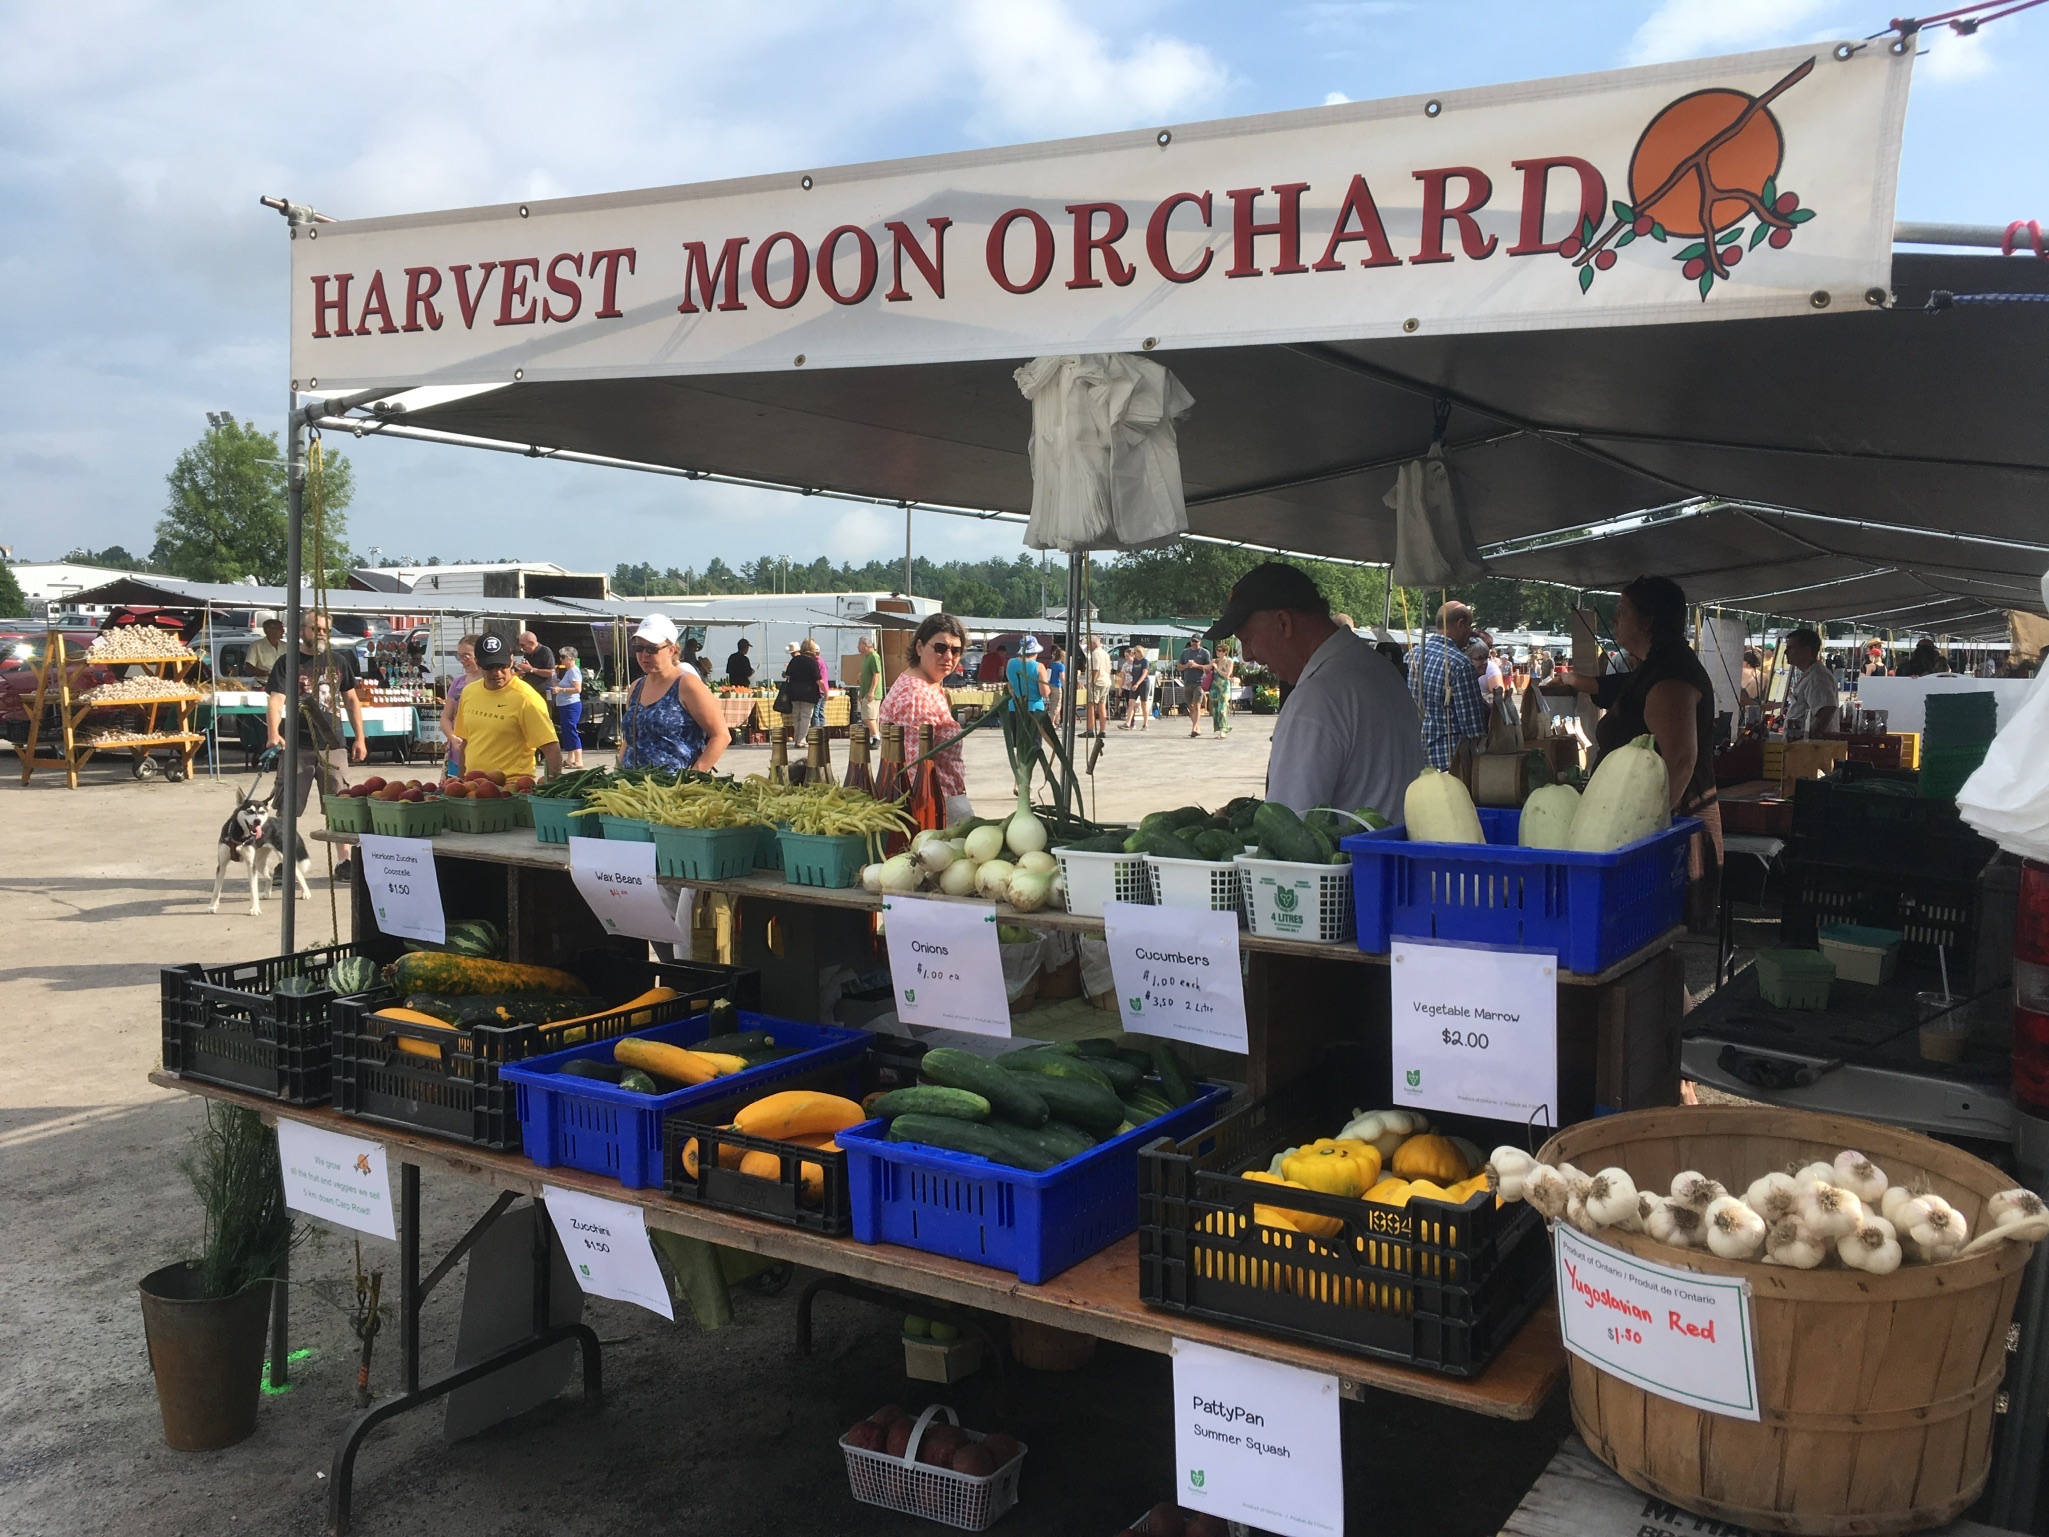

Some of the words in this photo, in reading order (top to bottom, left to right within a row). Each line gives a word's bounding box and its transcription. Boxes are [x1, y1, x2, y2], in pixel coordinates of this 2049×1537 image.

[311, 247, 636, 338] HARVEST
[677, 217, 953, 314] MOON
[986, 156, 1608, 294] ORCHARD
[371, 851, 395, 861] Heirloom
[395, 853, 418, 864] Zucchini
[384, 867, 411, 877] Cocozelle
[595, 871, 614, 882] Wax
[615, 873, 643, 886] Beans
[388, 882, 410, 895] $1.50
[1270, 912, 1276, 921] 4
[1278, 913, 1304, 925] LITRES
[911, 940, 949, 956] Onions
[1135, 947, 1210, 966] Cucumbers
[917, 962, 944, 980] $1.00
[948, 973, 960, 981] ea
[1142, 969, 1176, 987] $1.00
[1179, 976, 1201, 992] each
[1185, 1001, 1192, 1011] 2
[1195, 1002, 1214, 1013] Litre
[1413, 1001, 1471, 1018] Vegetable
[1474, 1007, 1520, 1023] Marrow
[1442, 1027, 1489, 1049] $2.00
[335, 1198, 351, 1211] Carp
[570, 1218, 611, 1236] Zucchini
[1369, 1209, 1412, 1238] 1994
[584, 1239, 610, 1253] $1.50
[1563, 1241, 1586, 1261] Product
[1587, 1257, 1594, 1265] of
[1595, 1260, 1623, 1279] Ontario
[1628, 1273, 1659, 1292] Produit
[1660, 1286, 1673, 1295] de
[1674, 1288, 1716, 1305] l'Ontario
[1564, 1258, 1653, 1324] Yugoslavian
[1668, 1310, 1716, 1343] Red
[1608, 1327, 1643, 1344] $1.50
[1193, 1396, 1265, 1427] PattyPan
[1194, 1424, 1242, 1446] Summer
[1245, 1437, 1291, 1458] Squash
